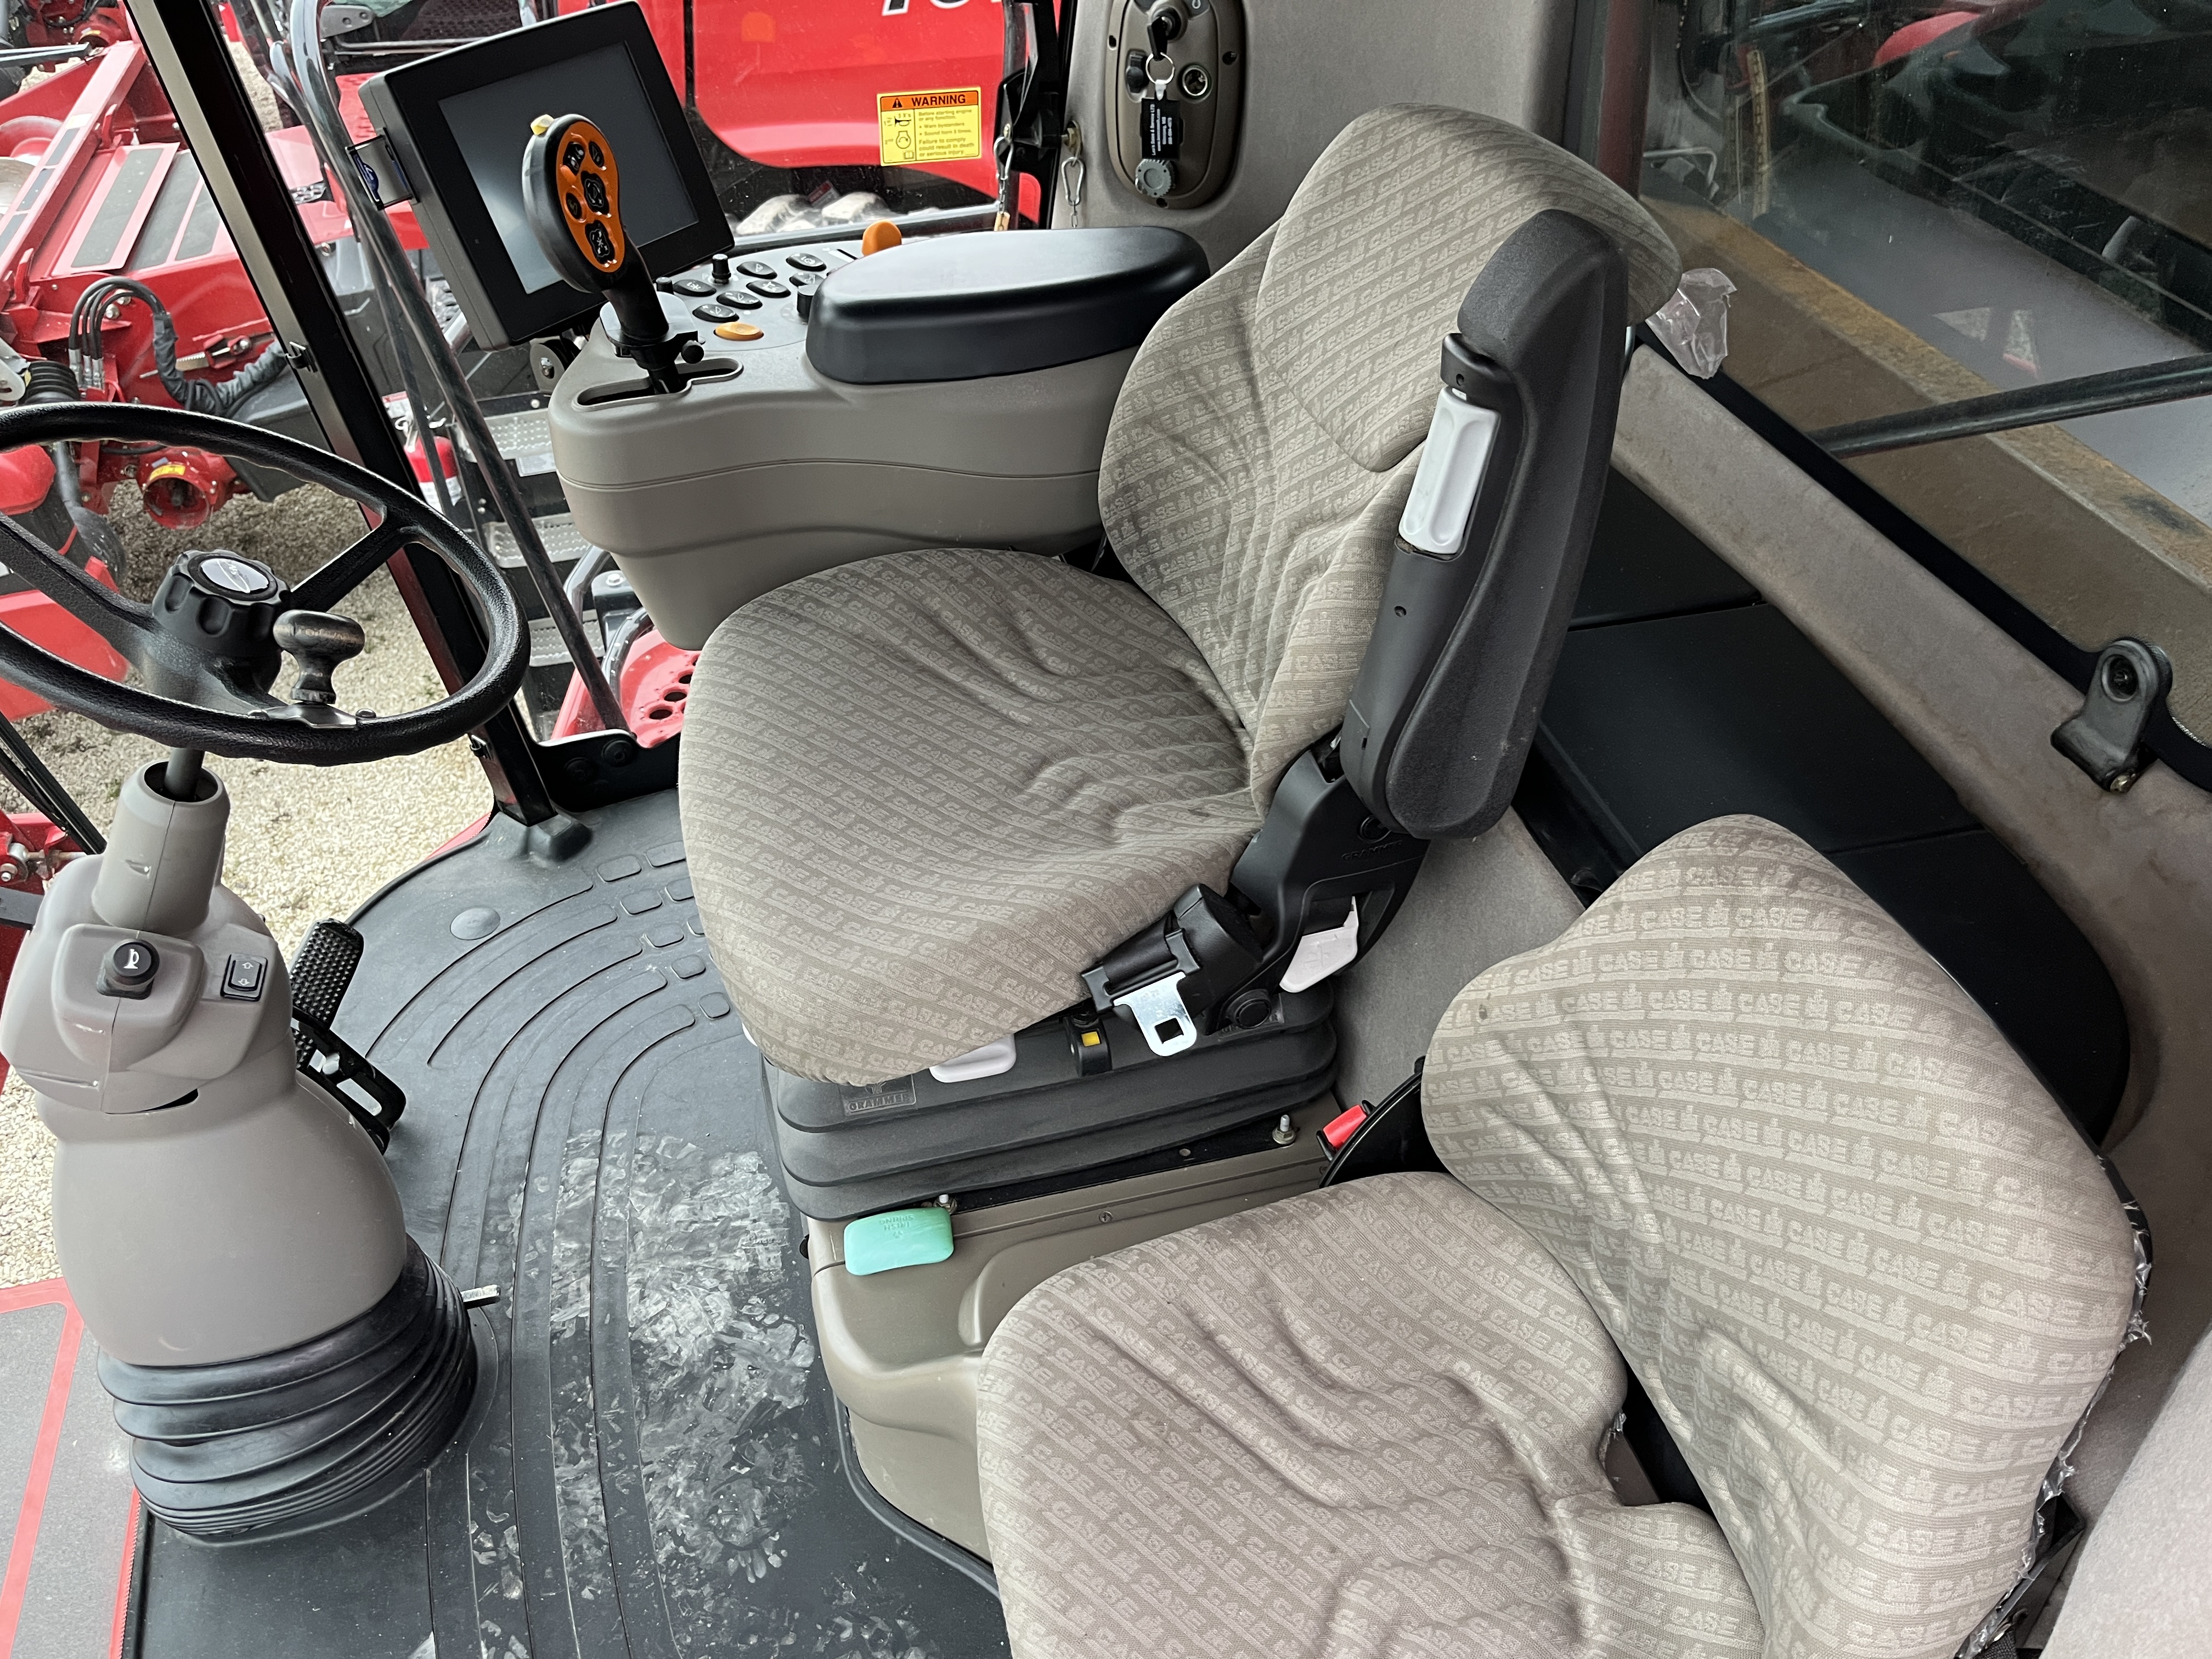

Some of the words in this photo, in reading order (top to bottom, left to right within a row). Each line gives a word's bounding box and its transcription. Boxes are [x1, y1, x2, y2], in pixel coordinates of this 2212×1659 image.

[911, 94, 966, 106] WARNING
[1640, 907, 1702, 929] CASE
[1735, 907, 1809, 928] CASE
[1514, 960, 1568, 984] CASE
[1598, 951, 1658, 971] CASE
[1690, 948, 1751, 970] CASE
[1785, 951, 1864, 976] CASE
[1562, 991, 1617, 1012] CASE
[1649, 990, 1708, 1009] CASE
[1737, 992, 1801, 1014] CASE
[1835, 1001, 1916, 1028] CASE
[1448, 1040, 1505, 1063] CASE
[1527, 1030, 1583, 1052] CASE
[1610, 1029, 1667, 1048] CASE
[1696, 1032, 1755, 1056] CASE
[1786, 1041, 1850, 1068] CASE
[1884, 1052, 1973, 1087] CASE
[1658, 1071, 1713, 1093] CASE
[1742, 1079, 1802, 1107] CASE
[1833, 1094, 1899, 1123] CASE
[1937, 1111, 2034, 1151] CASE
[1626, 1106, 1675, 1128] CASE
[1703, 1115, 1758, 1142] CASE
[1788, 1130, 1848, 1162] CASE
[1880, 1150, 1950, 1184] CASE
[878, 1215, 914, 1225] SPRING
[1670, 1150, 1720, 1177] CASE
[1747, 1166, 1802, 1198] CASE
[1831, 1187, 1893, 1222] CASE
[1926, 1213, 2010, 1253] CASE
[884, 1221, 910, 1231] IRISH
[1469, 1254, 1525, 1291] CASE
[1710, 1199, 1760, 1230] CASE
[1788, 1221, 1844, 1257] CASE
[1872, 1248, 1940, 1287] CASE
[1977, 1281, 2084, 1326] CASE
[1680, 1231, 1726, 1261] CASE
[1751, 1255, 1801, 1289] CASE
[1826, 1281, 1883, 1321] CASE
[1912, 1314, 1995, 1361] CASE
[1430, 1310, 1490, 1345] CASE
[1491, 1310, 1551, 1345] CASE
[1719, 1284, 1764, 1316] CASE
[1787, 1312, 1836, 1353] CASE
[1860, 1345, 1922, 1390] CASE
[1961, 1386, 2061, 1417] CASE
[1454, 1360, 1513, 1398] CASE
[1514, 1359, 1574, 1397] CASE
[1758, 1345, 1801, 1382] CASE
[1818, 1377, 1866, 1420] CASE
[1891, 1415, 1979, 1459] CASE
[1943, 1474, 2029, 1504] CASE
[1866, 1519, 1957, 1555] CASE
[1627, 1554, 1697, 1585] CASE
[1817, 1544, 1878, 1597] CASE
[1846, 1620, 1950, 1647] CASE
